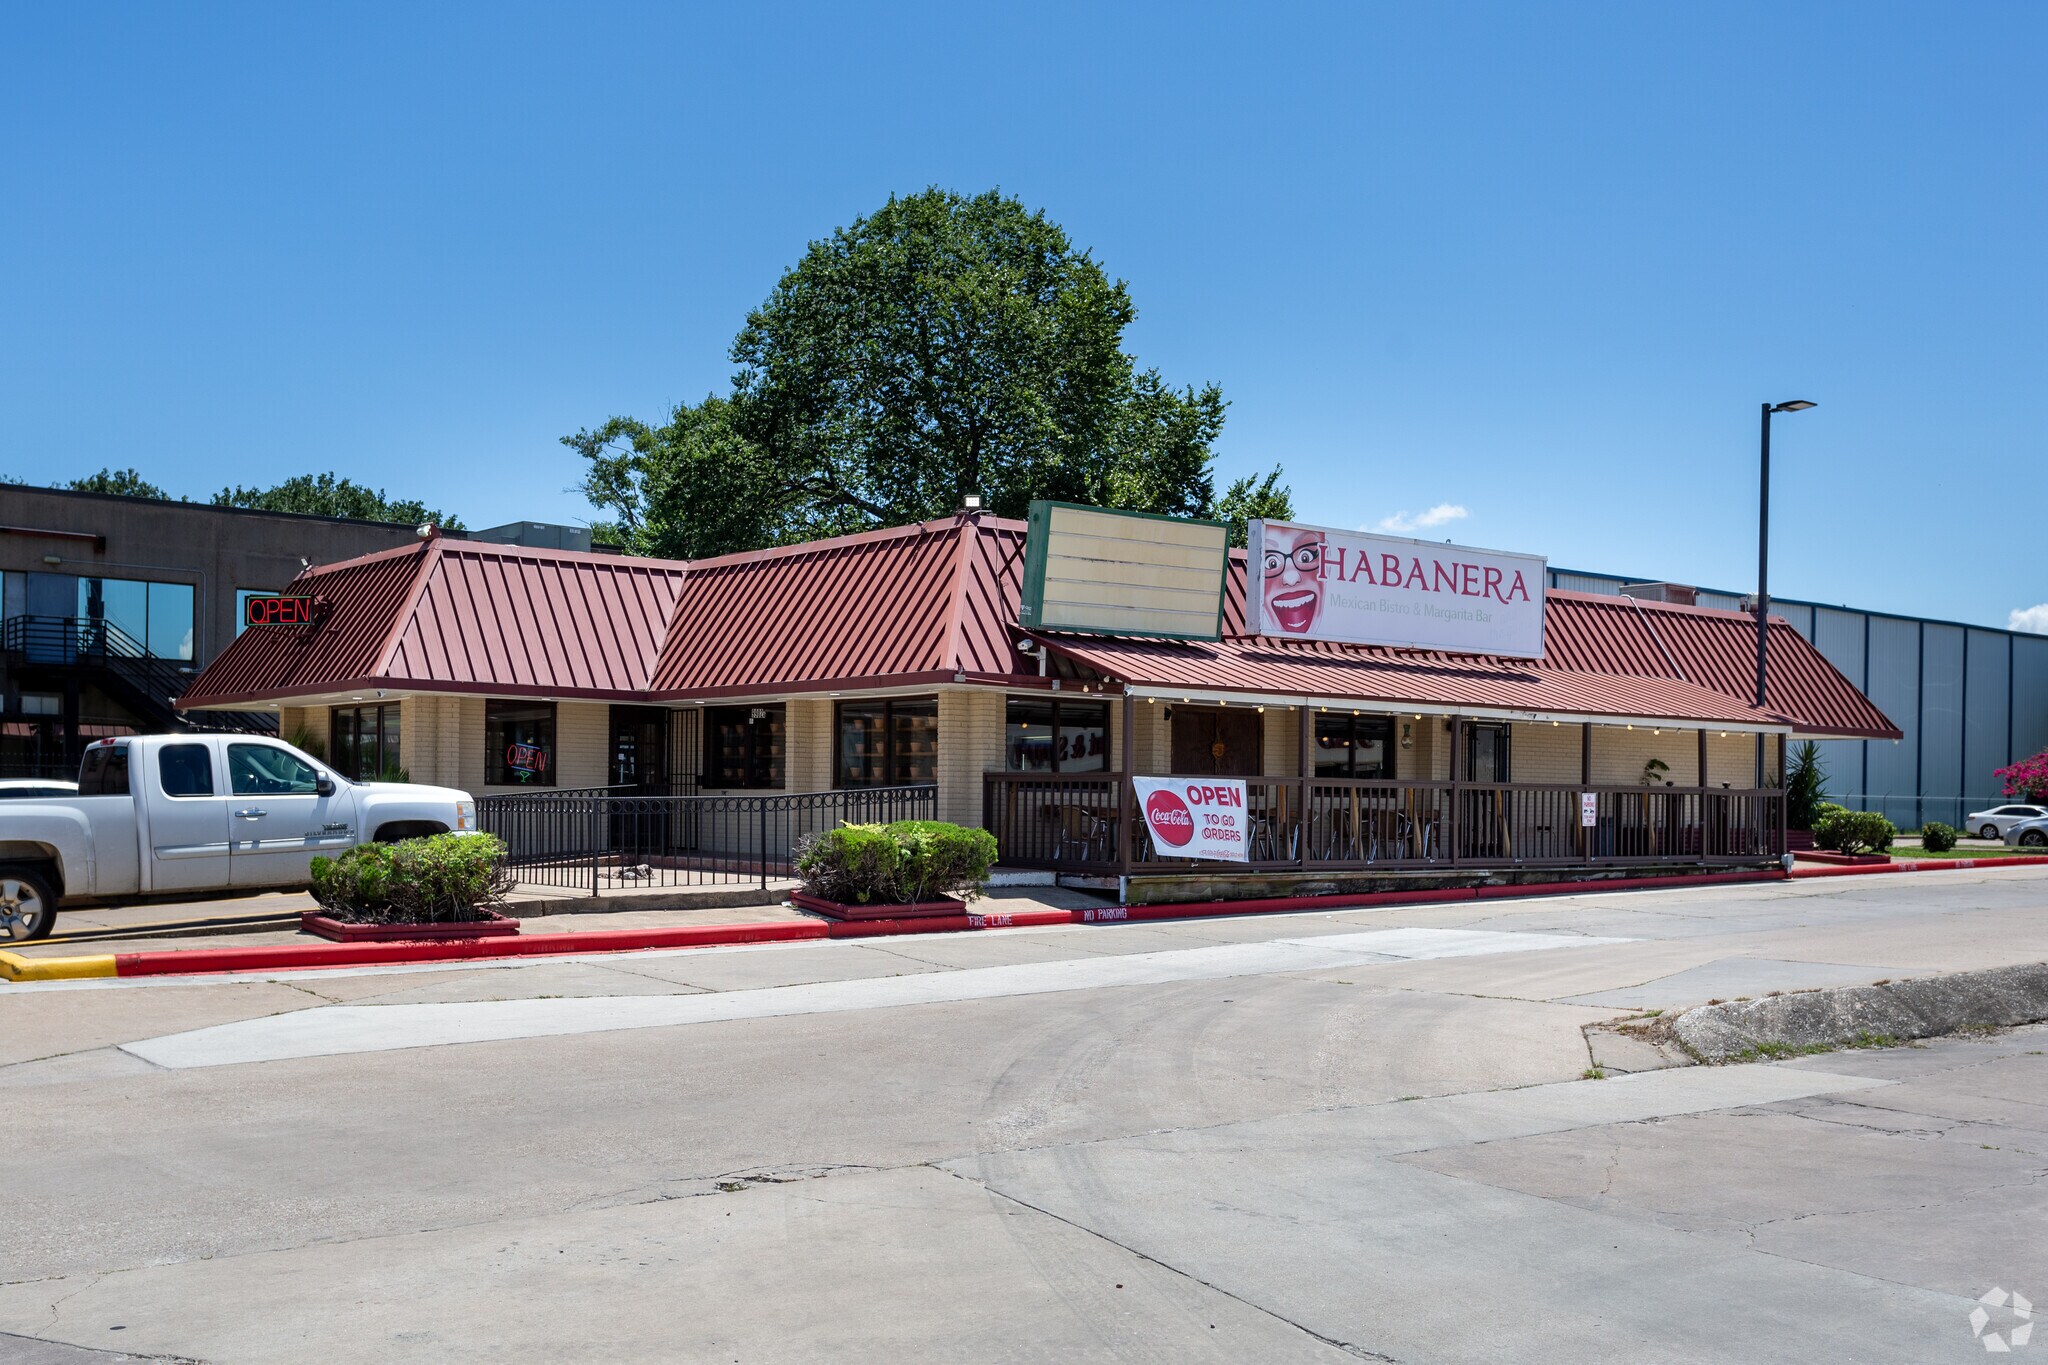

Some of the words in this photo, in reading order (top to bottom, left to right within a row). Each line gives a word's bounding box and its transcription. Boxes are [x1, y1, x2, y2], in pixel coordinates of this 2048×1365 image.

[1318, 545, 1531, 604] HABANERA
[249, 598, 311, 624] OPEN
[1330, 593, 1376, 611] Mexican
[1379, 599, 1410, 615] Bistro
[1413, 603, 1421, 616] &
[1424, 604, 1473, 622] Margarita
[1476, 609, 1493, 623] Bar
[507, 745, 547, 772] OPEN
[1186, 785, 1242, 808] OPEN
[1203, 813, 1220, 825] TO
[1221, 814, 1235, 827] GO
[1202, 827, 1242, 841] ORDERS
[968, 915, 987, 927] FIRE
[991, 914, 1013, 926] LANE
[1084, 910, 1095, 921] NO
[1097, 907, 1127, 920] PARKING
